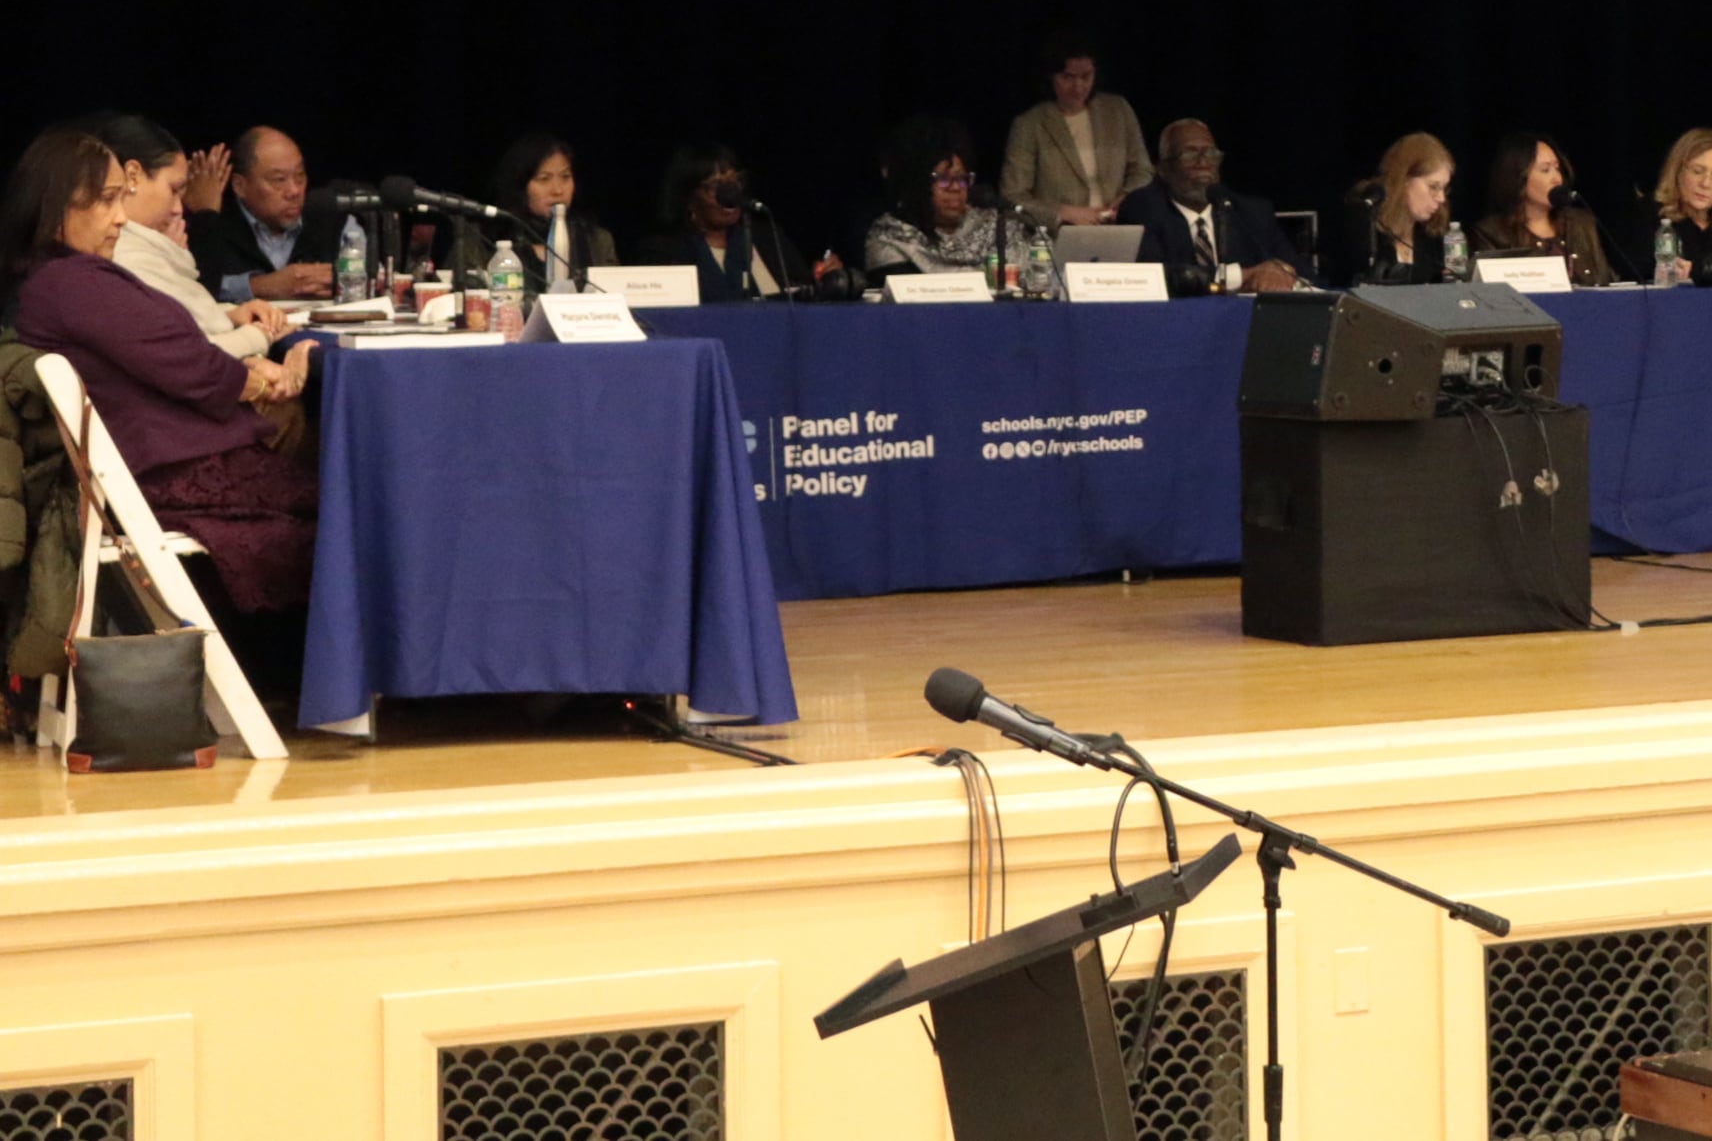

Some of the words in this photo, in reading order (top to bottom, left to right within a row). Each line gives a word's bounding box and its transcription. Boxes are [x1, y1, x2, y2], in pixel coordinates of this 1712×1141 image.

[782, 412, 858, 438] Panel
[866, 411, 897, 433] for
[981, 409, 1148, 434] schools.nyc.gov/PEP
[784, 435, 934, 468] Educational
[786, 472, 867, 498] Policy
